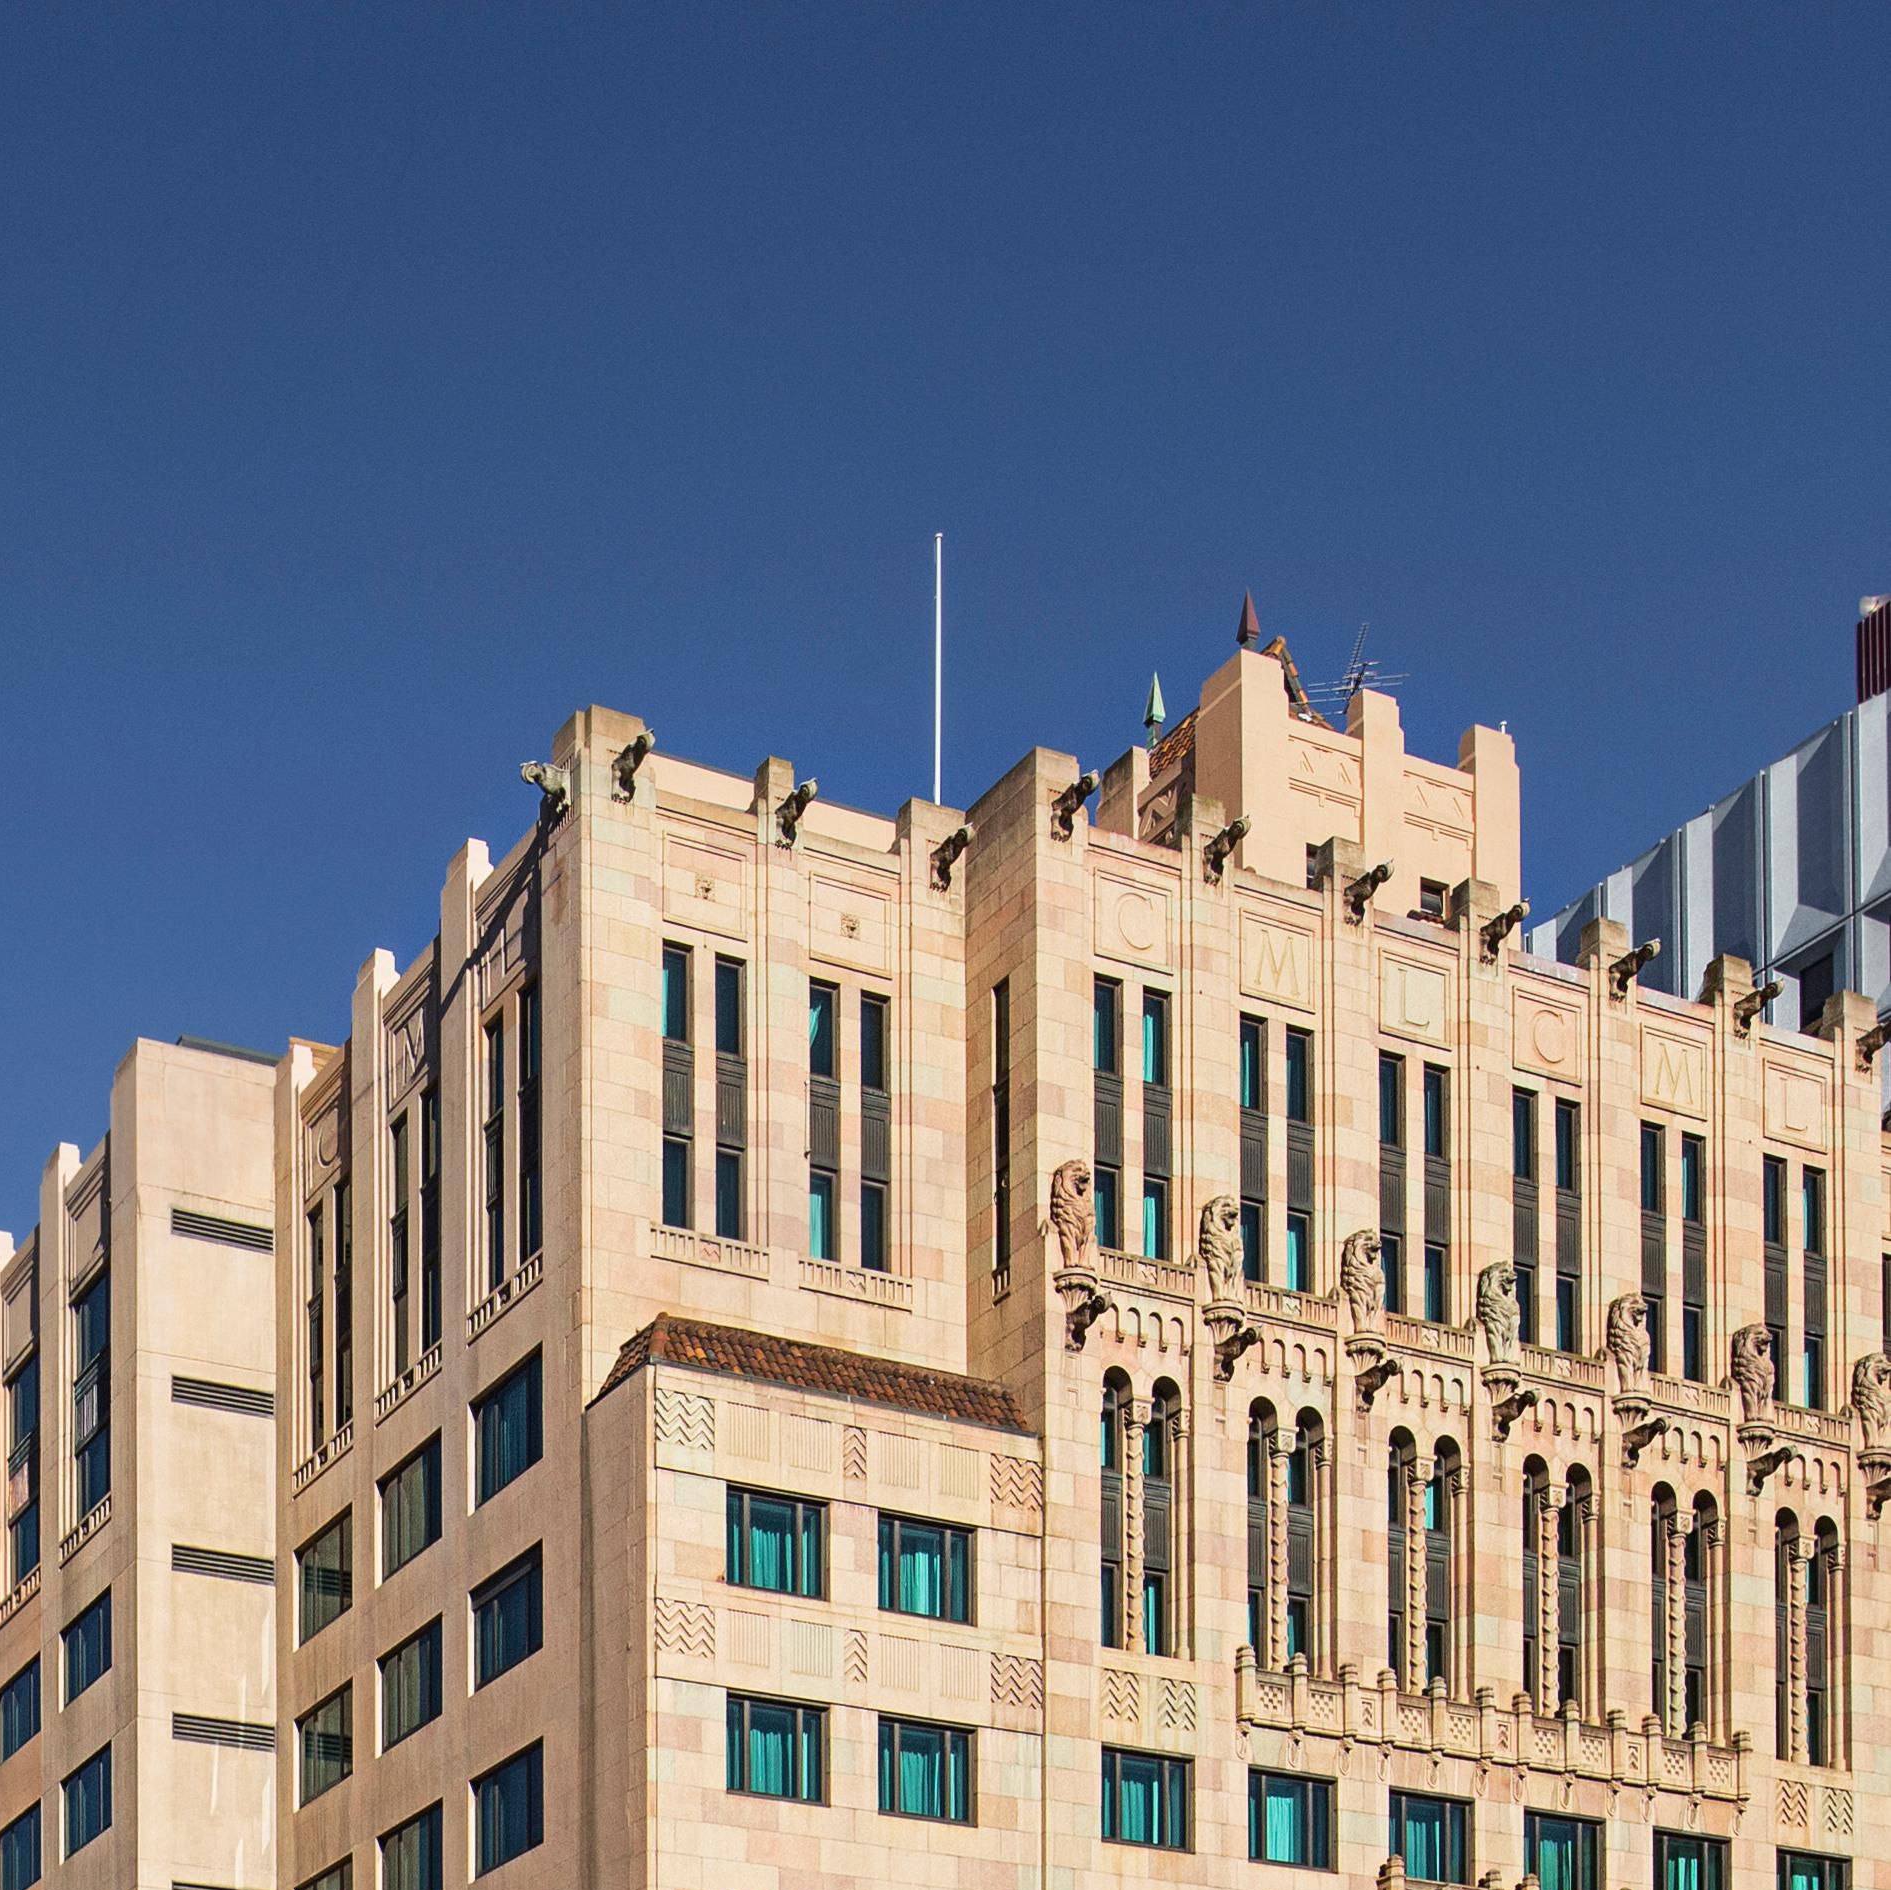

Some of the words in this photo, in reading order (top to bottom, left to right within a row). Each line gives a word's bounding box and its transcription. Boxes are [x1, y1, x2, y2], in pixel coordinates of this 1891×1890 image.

[1116, 891, 1154, 951] C
[1253, 929, 1301, 996] M
[1397, 967, 1431, 1030] L
[1532, 1009, 1566, 1064] C
[1655, 1042, 1694, 1105] M
[1779, 1076, 1808, 1131] L
